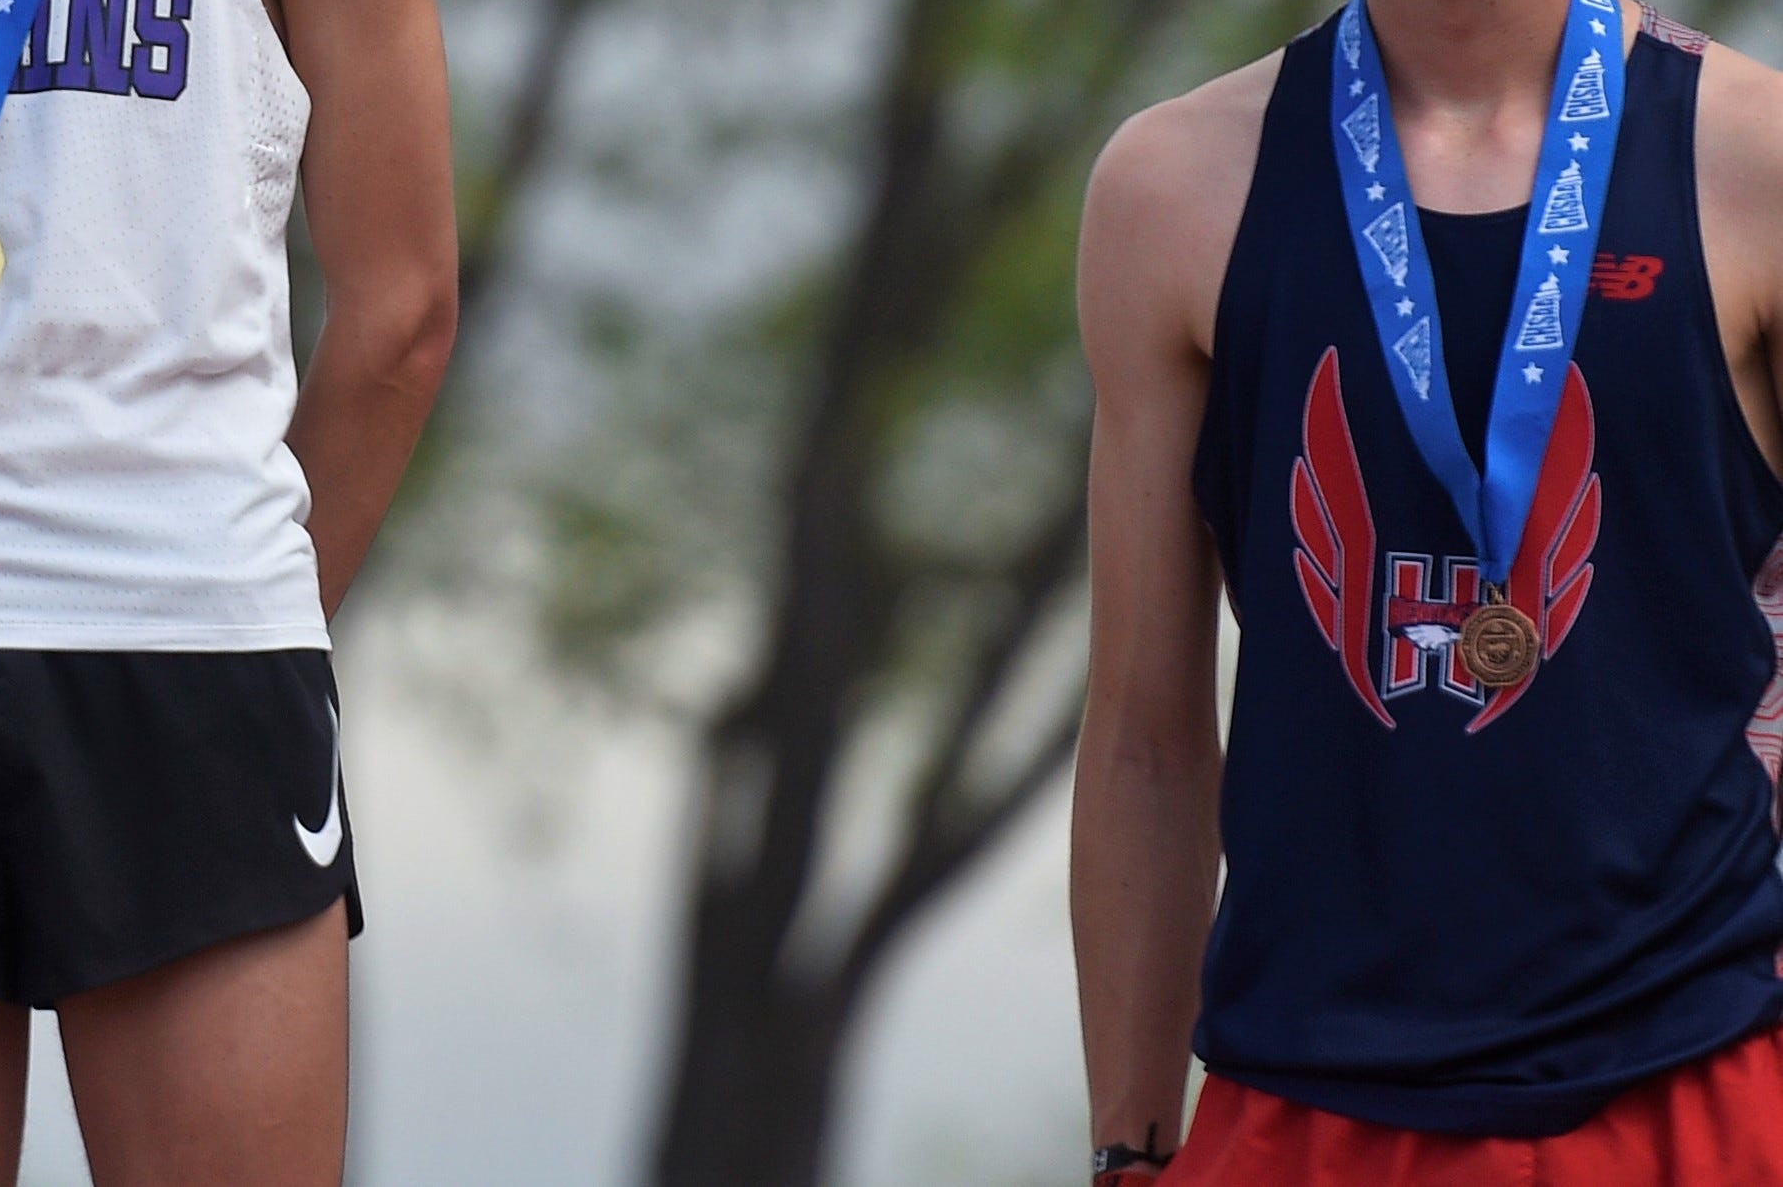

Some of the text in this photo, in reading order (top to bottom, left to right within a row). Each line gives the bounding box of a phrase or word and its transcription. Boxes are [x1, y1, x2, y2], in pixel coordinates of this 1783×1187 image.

[1565, 70, 1604, 118] CHSAA
[1544, 183, 1583, 230] CHSAA
[1520, 297, 1559, 347] CHSAA
